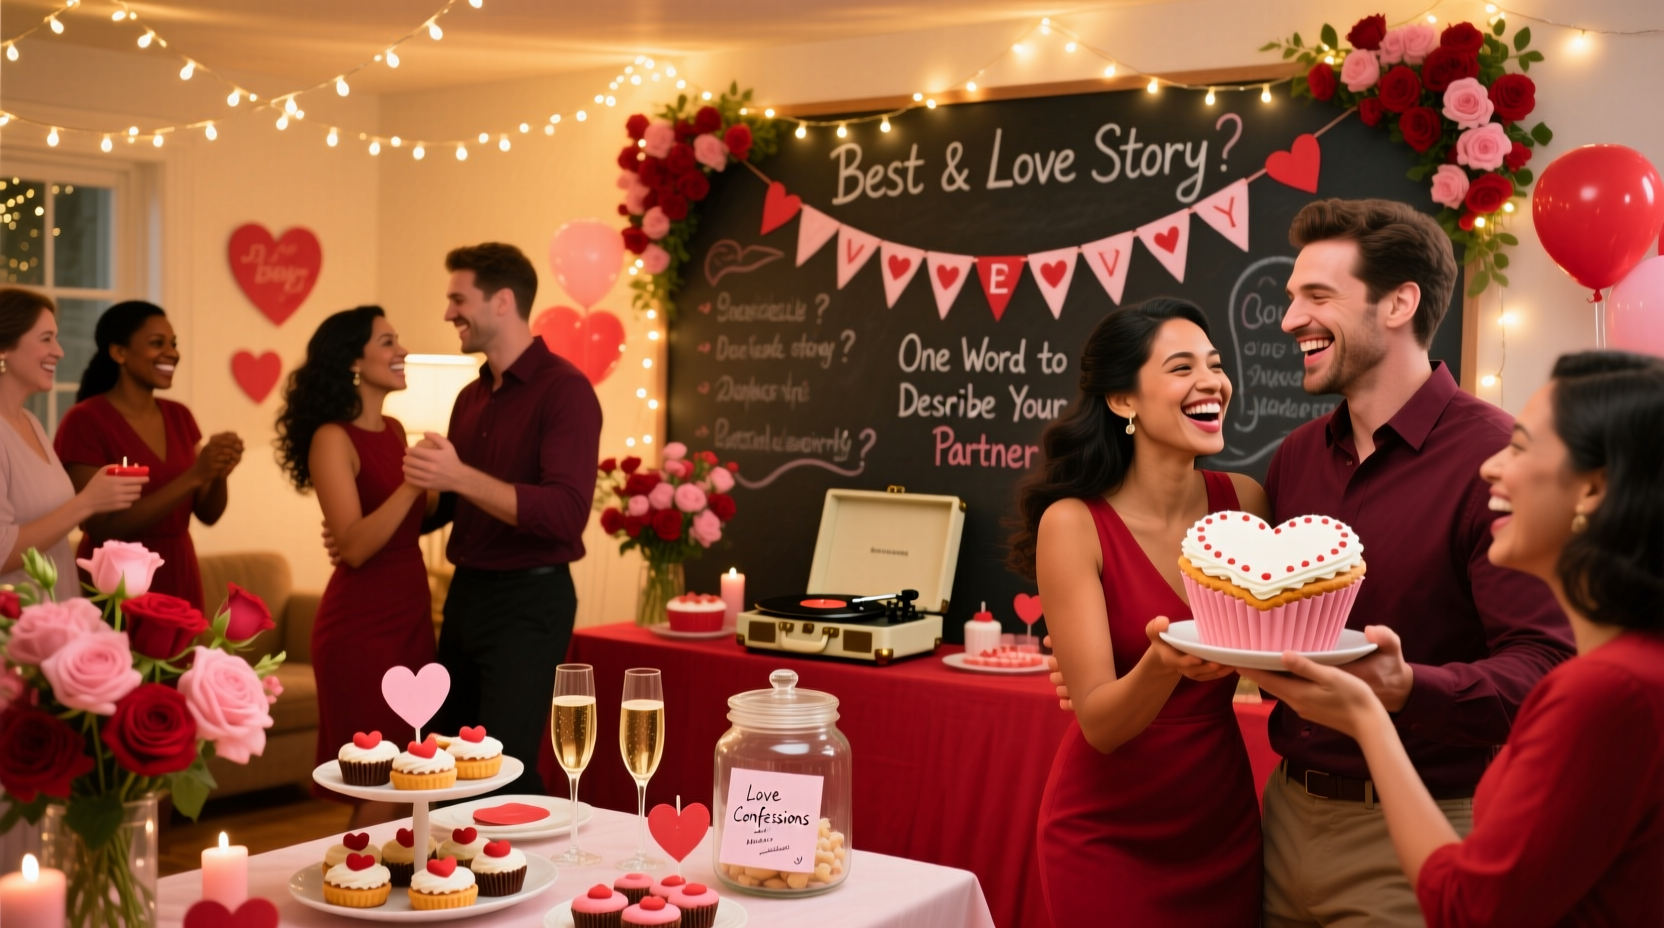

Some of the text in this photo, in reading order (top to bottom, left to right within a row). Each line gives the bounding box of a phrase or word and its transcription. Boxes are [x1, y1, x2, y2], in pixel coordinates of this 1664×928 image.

[830, 143, 925, 205] Best
[941, 141, 971, 192] &
[986, 128, 1077, 190] Love
[988, 263, 1009, 295] E
[1213, 197, 1237, 228] Y
[898, 333, 1068, 374] One Word to
[898, 382, 1068, 422] Desribe Your
[932, 426, 1039, 470] Partner
[746, 783, 782, 802] Love
[733, 806, 810, 828] Confessions
